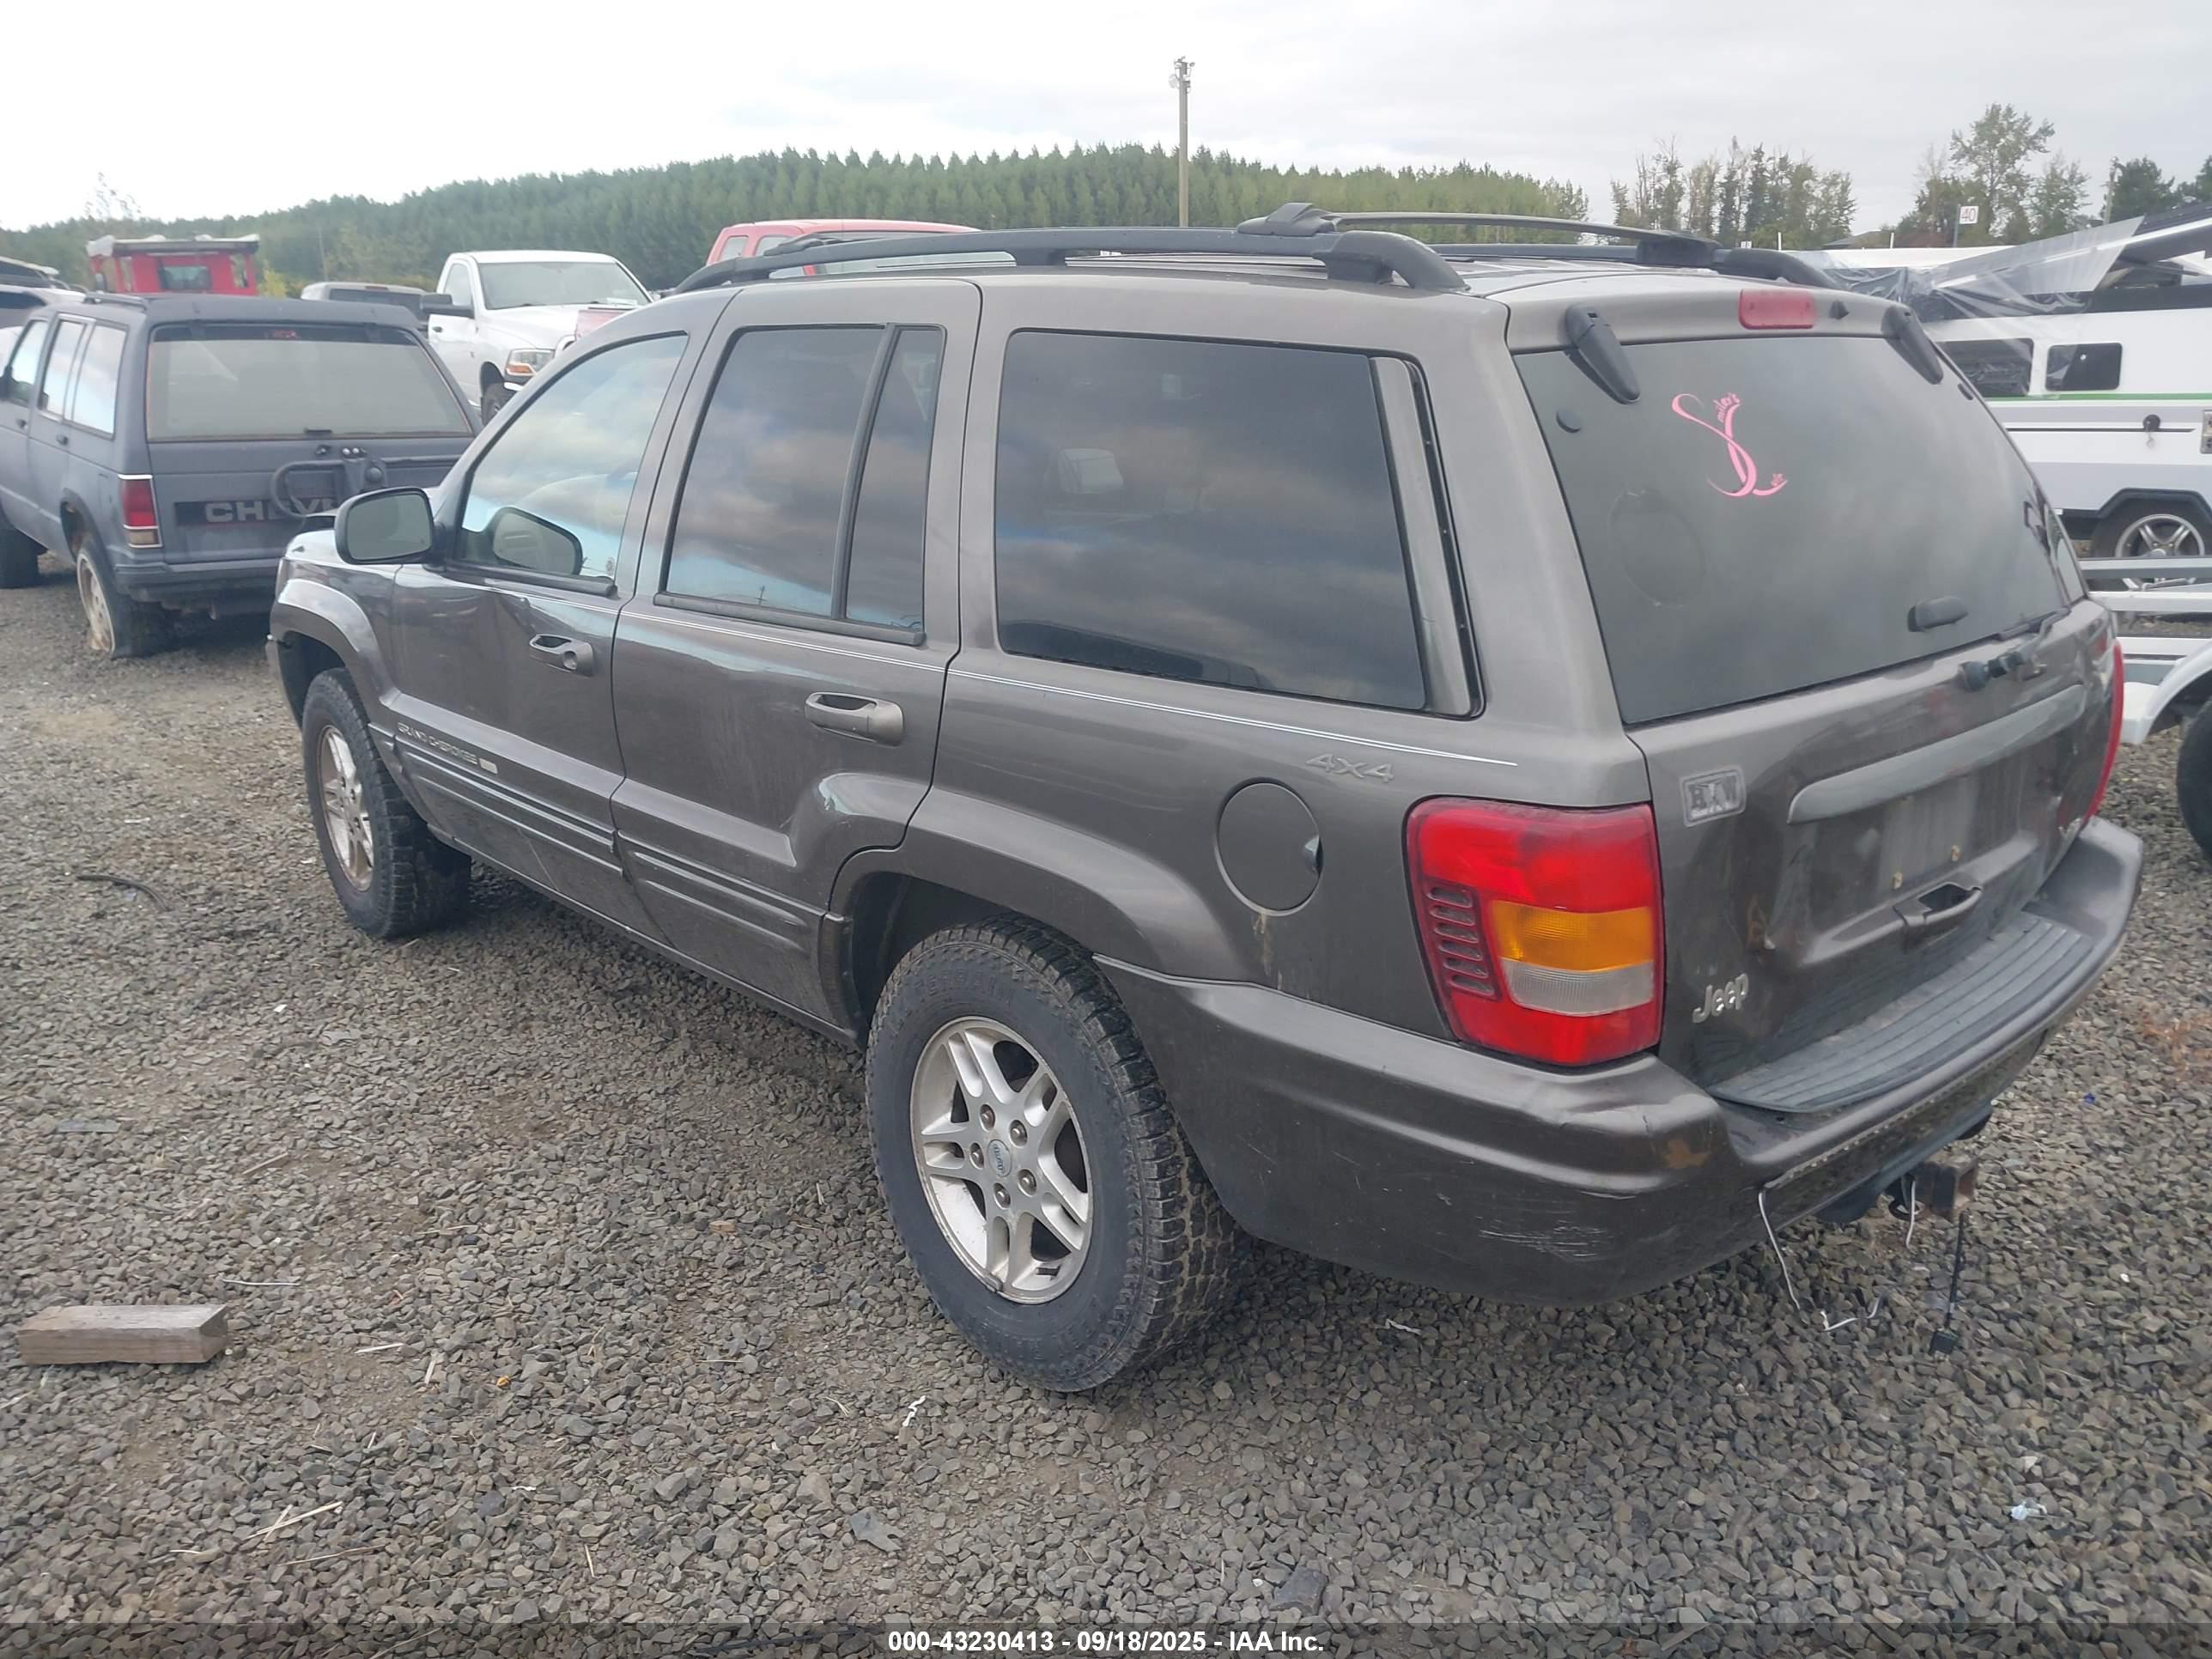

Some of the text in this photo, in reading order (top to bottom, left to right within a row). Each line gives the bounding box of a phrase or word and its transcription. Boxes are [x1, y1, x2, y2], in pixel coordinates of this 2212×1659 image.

[1961, 207, 1977, 222] 40
[204, 495, 337, 523] CHV
[1691, 972, 1749, 1024] Jeep
